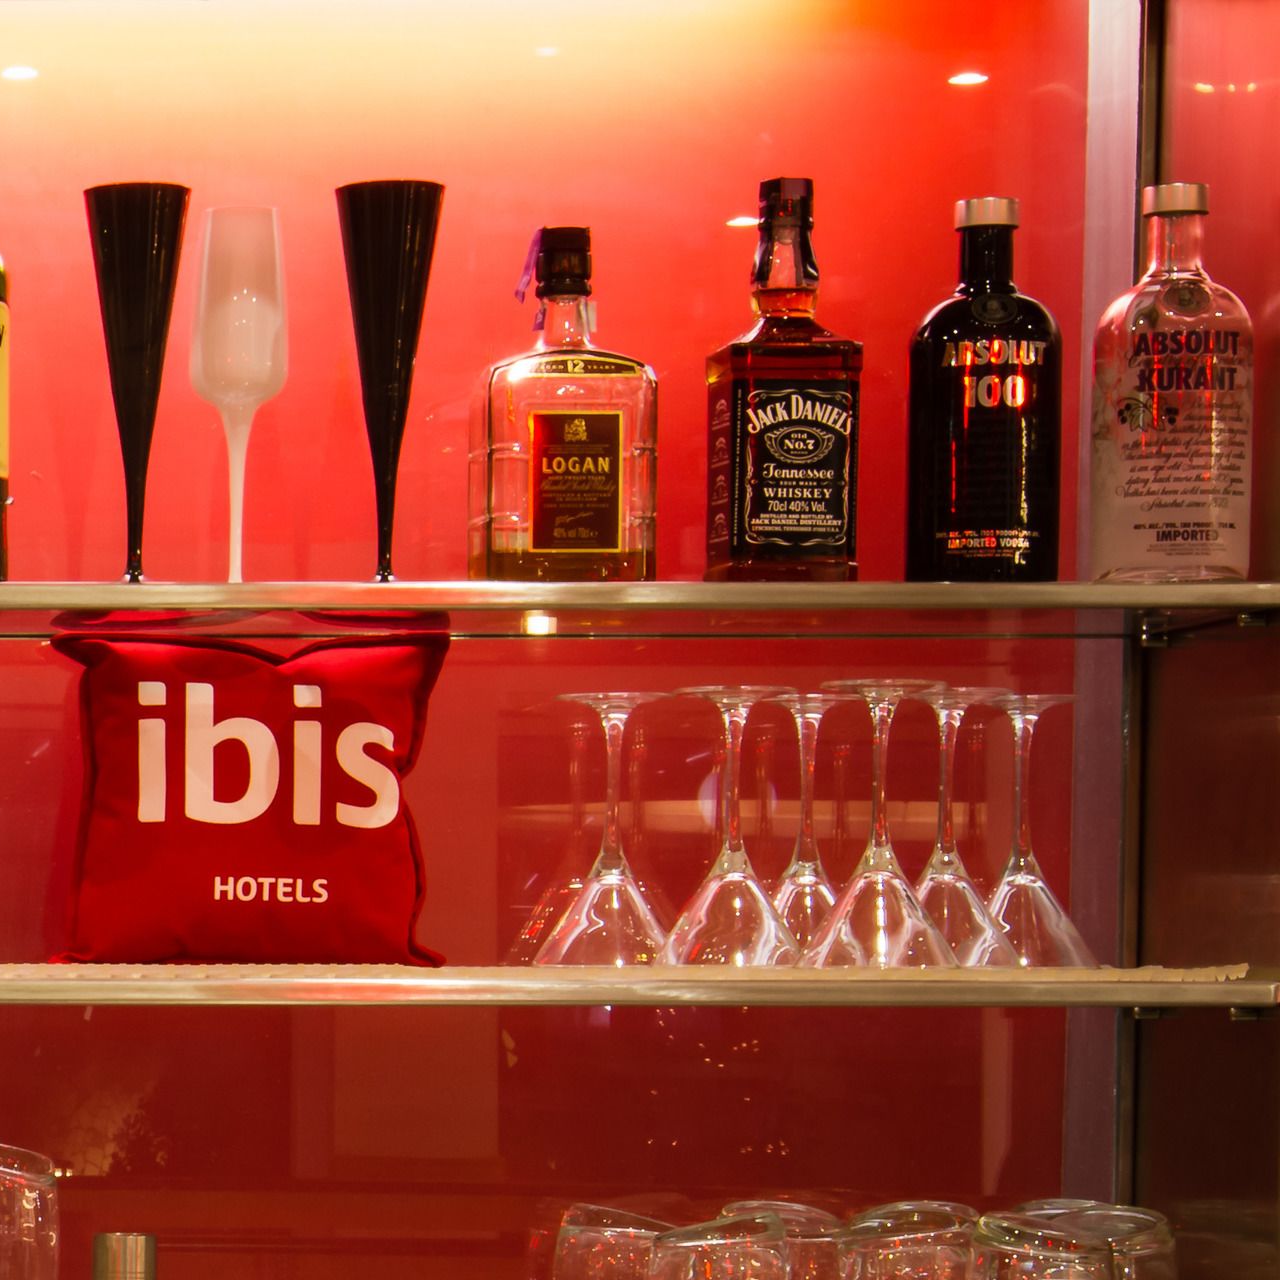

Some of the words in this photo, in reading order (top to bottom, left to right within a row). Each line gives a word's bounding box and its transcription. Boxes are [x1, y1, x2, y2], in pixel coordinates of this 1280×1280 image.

[1133, 330, 1240, 357] ABSOLUT
[942, 339, 1047, 367] ABSOLUT
[567, 359, 585, 373] 12
[1136, 366, 1237, 392] KURANT
[964, 375, 1025, 408] 100
[745, 401, 789, 434] JACK
[783, 438, 816, 450] No.7
[791, 432, 808, 440] Old
[542, 457, 610, 474] LOGAN
[762, 462, 835, 479] Tennessee
[763, 487, 833, 499] WHISKEY
[768, 500, 787, 512] 70cl
[788, 500, 809, 512] 40%
[811, 501, 828, 512] Vol.
[771, 518, 798, 526] DANIEL
[947, 538, 997, 549] IMPORTED
[1156, 530, 1219, 542] IMPORTED
[137, 681, 400, 829] ibis
[214, 876, 329, 903] HOTELS
